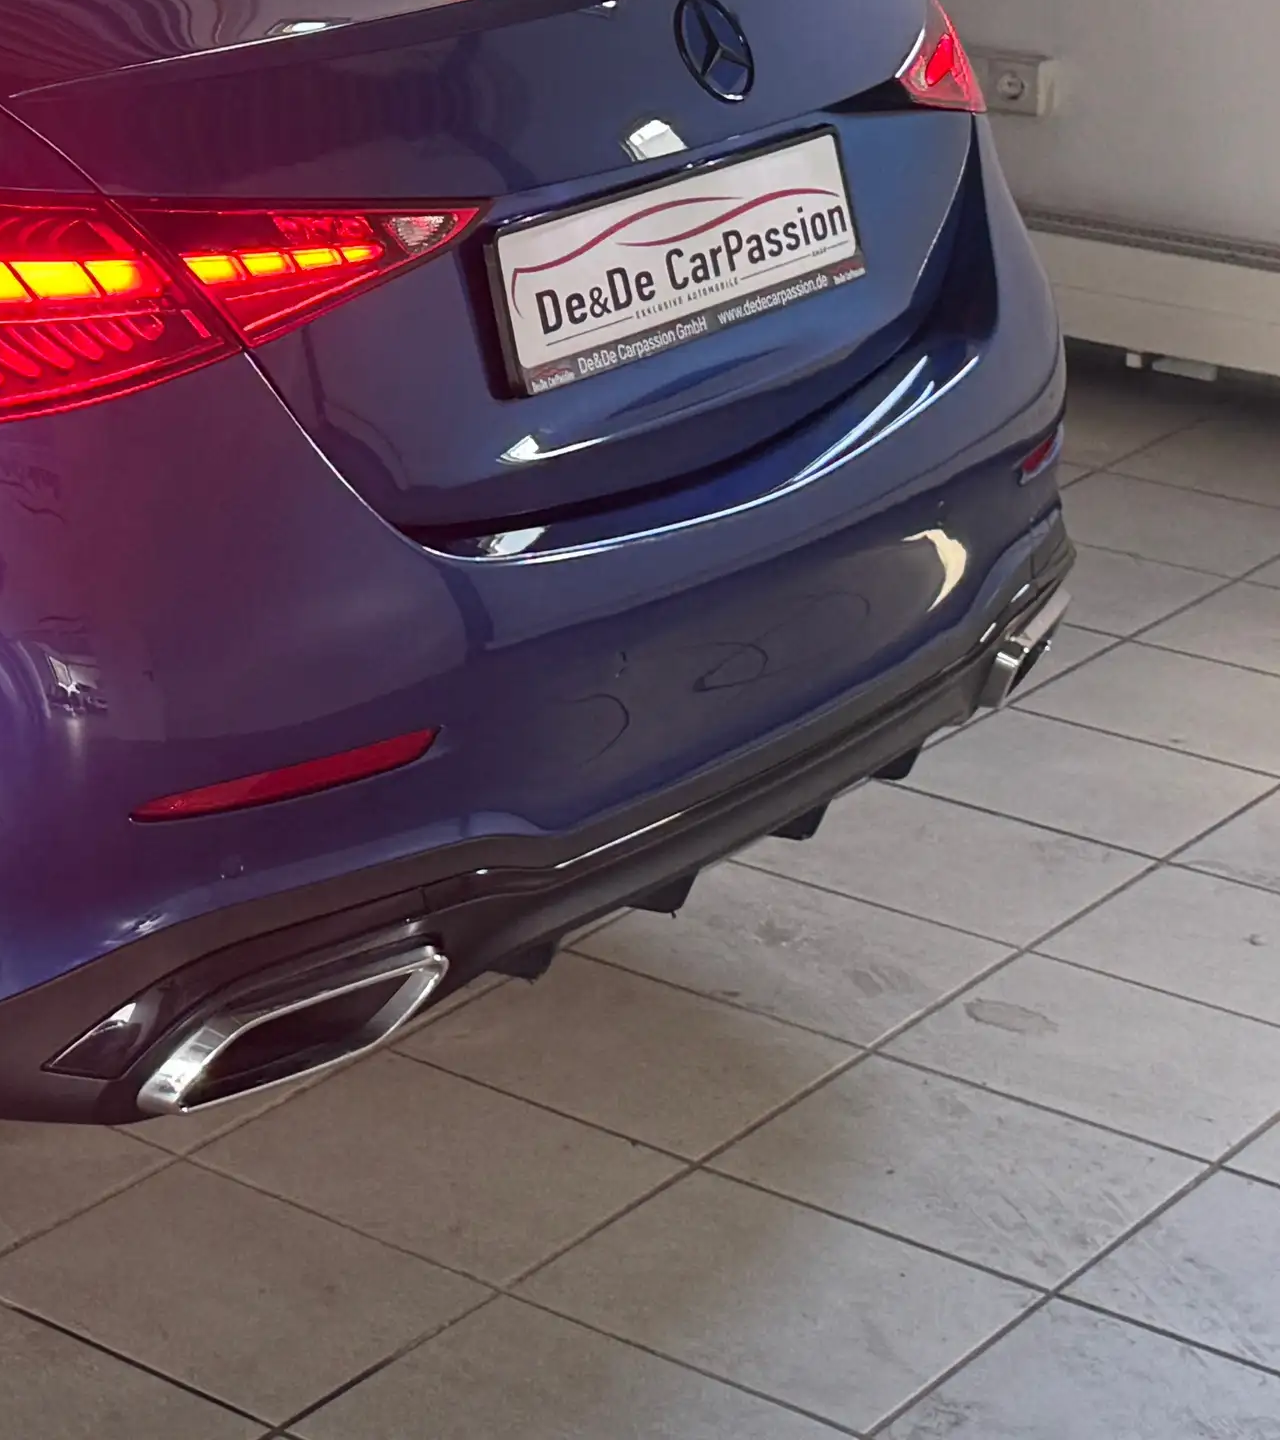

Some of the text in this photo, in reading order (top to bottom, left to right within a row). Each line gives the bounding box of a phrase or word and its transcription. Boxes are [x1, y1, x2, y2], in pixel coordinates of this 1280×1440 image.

[535, 205, 848, 336] De&De CarPassion
[577, 349, 618, 375] De&De
[617, 330, 676, 361] Carpassion
[675, 315, 709, 341] GmbH
[717, 272, 829, 325] www.dedecarpassion.de
